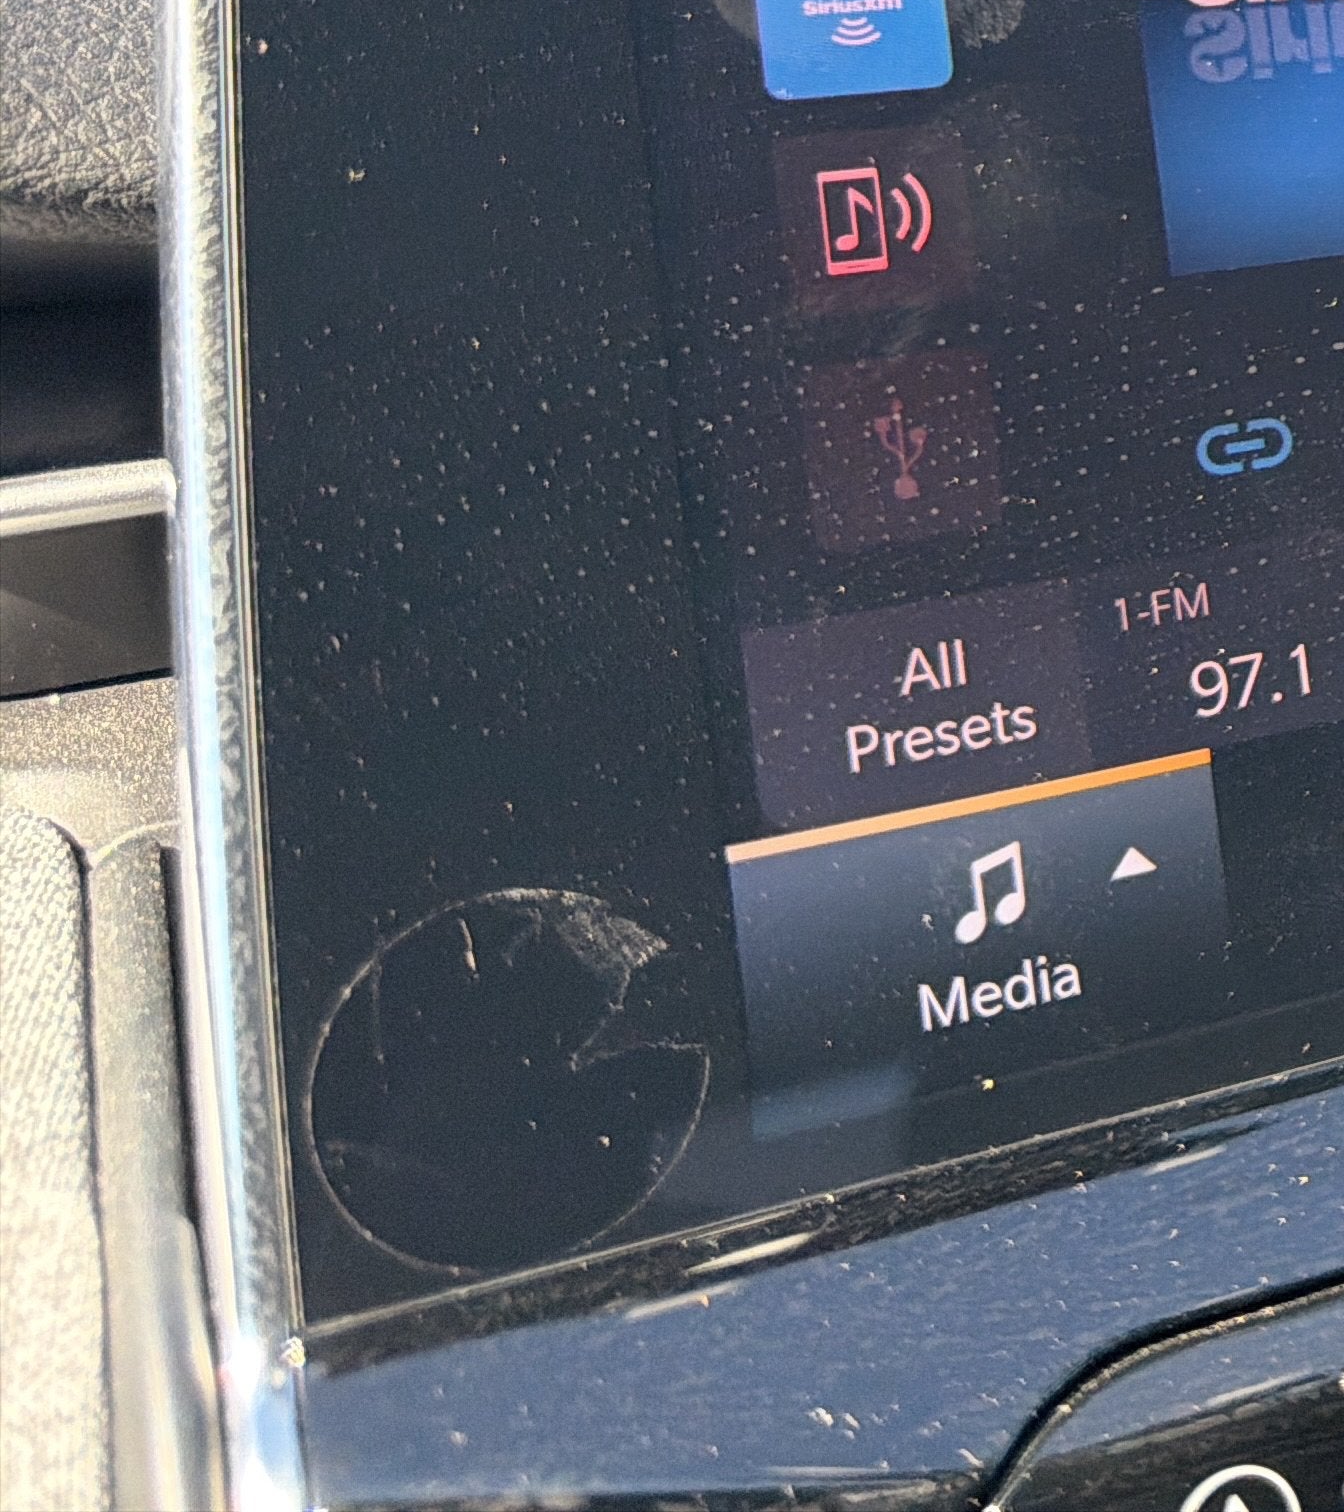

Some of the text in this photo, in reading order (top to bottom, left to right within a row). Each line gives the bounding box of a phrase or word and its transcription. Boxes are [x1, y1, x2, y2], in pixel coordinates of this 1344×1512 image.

[1114, 583, 1210, 631] 1-FM
[900, 639, 967, 696] All
[1190, 643, 1311, 717] 97.1
[847, 702, 1037, 774] Presets
[917, 954, 1081, 1032] Media
